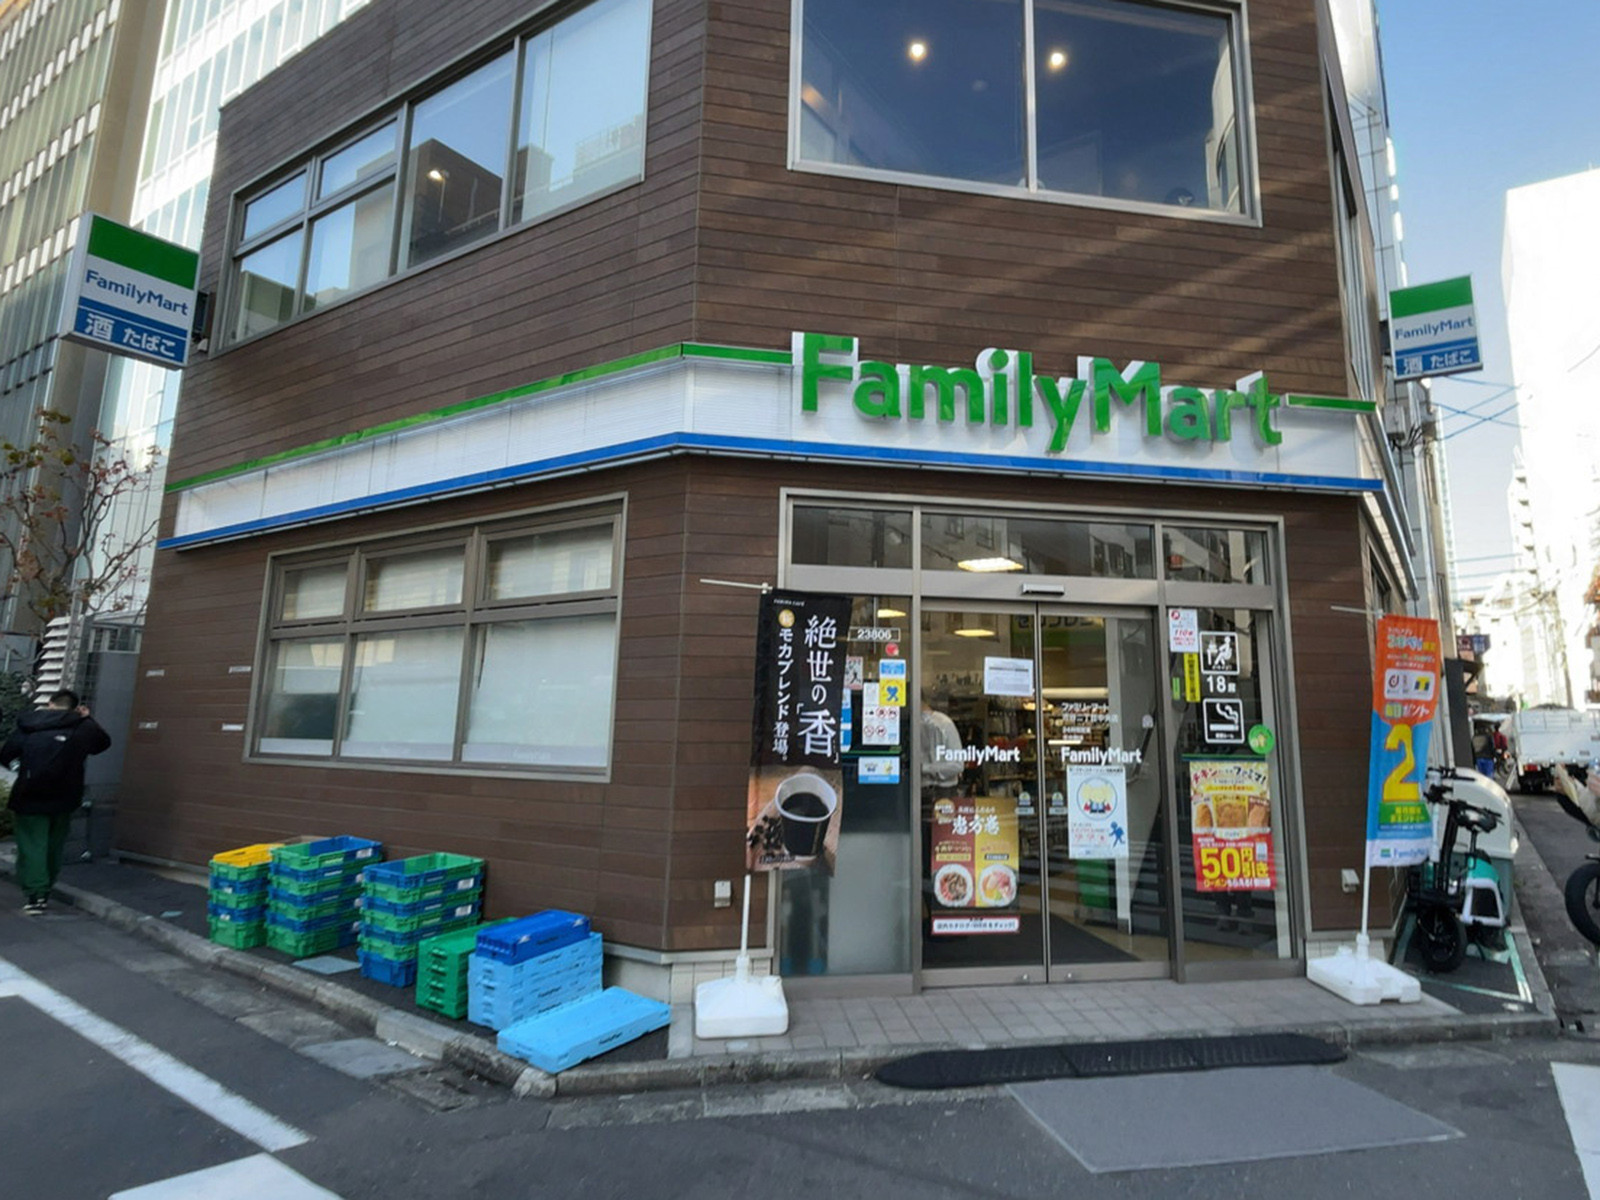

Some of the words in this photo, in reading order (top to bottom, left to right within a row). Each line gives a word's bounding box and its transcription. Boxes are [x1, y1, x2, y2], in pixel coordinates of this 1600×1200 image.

[86, 269, 188, 316] FamilyMart
[85, 312, 114, 341] 酒
[124, 327, 176, 358] たばこ
[1395, 316, 1474, 340] FamilyMart
[1403, 354, 1423, 375] 酒
[1430, 350, 1473, 369] たばこ
[792, 332, 1284, 453] FamilyMart
[935, 745, 1021, 766] FamilyMart
[1061, 746, 1142, 766] FamilyMart
[1382, 723, 1419, 803] 2
